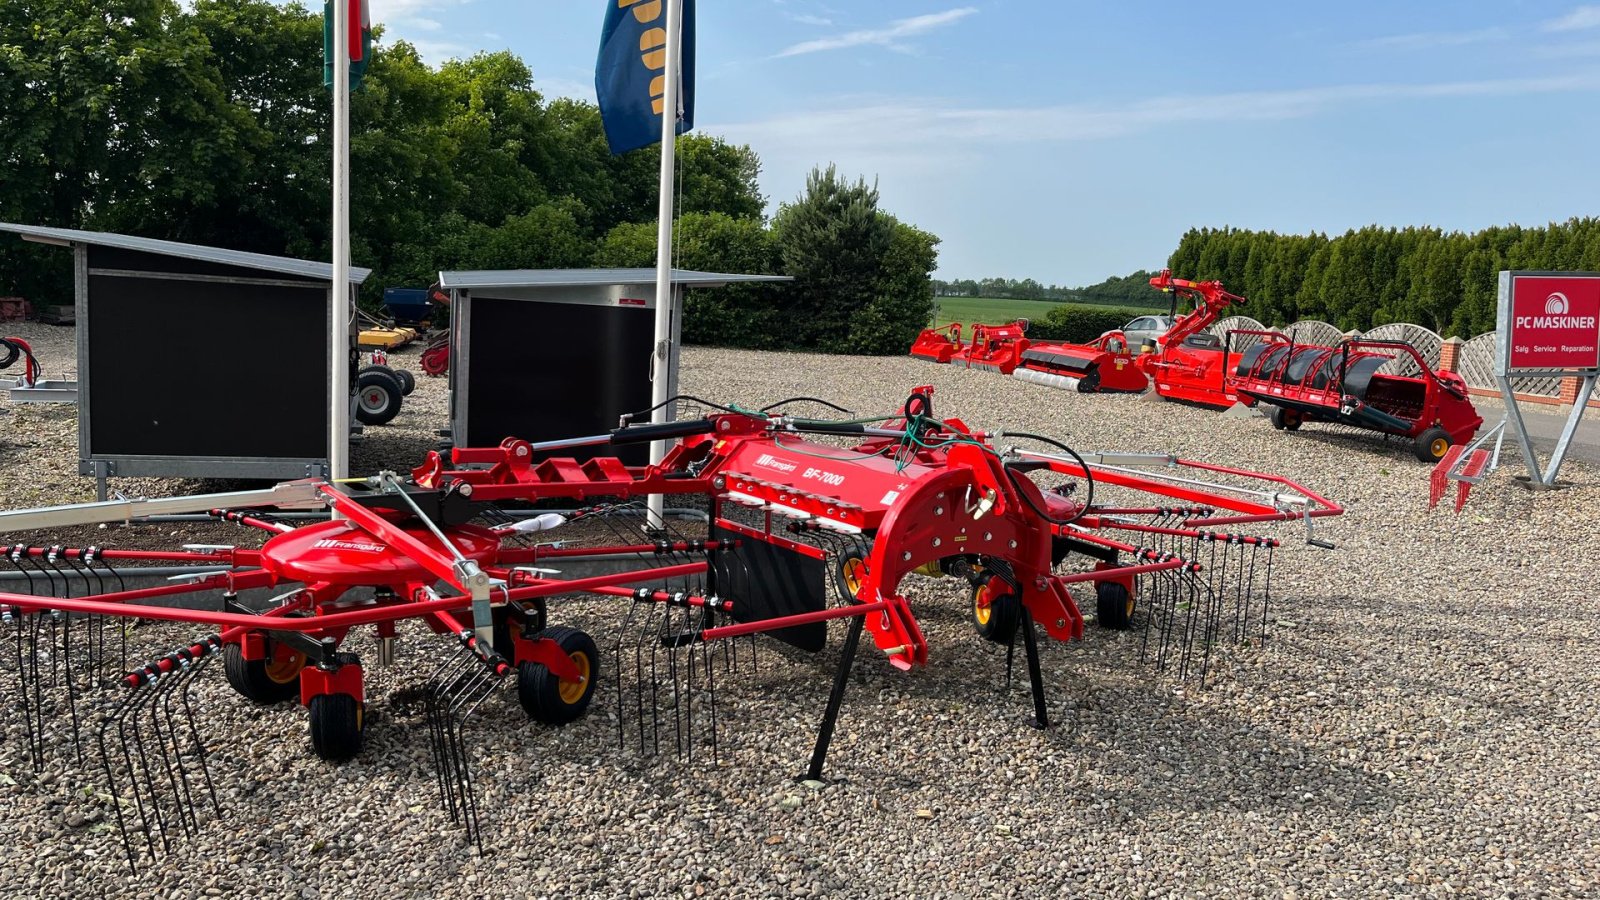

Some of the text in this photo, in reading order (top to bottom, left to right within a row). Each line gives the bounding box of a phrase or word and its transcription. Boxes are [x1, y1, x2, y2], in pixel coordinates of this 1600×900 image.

[1516, 317, 1595, 328] PC MASKINER
[1515, 345, 1529, 353] Salg
[1561, 345, 1593, 353] Reparation
[802, 467, 845, 485] BF-7000
